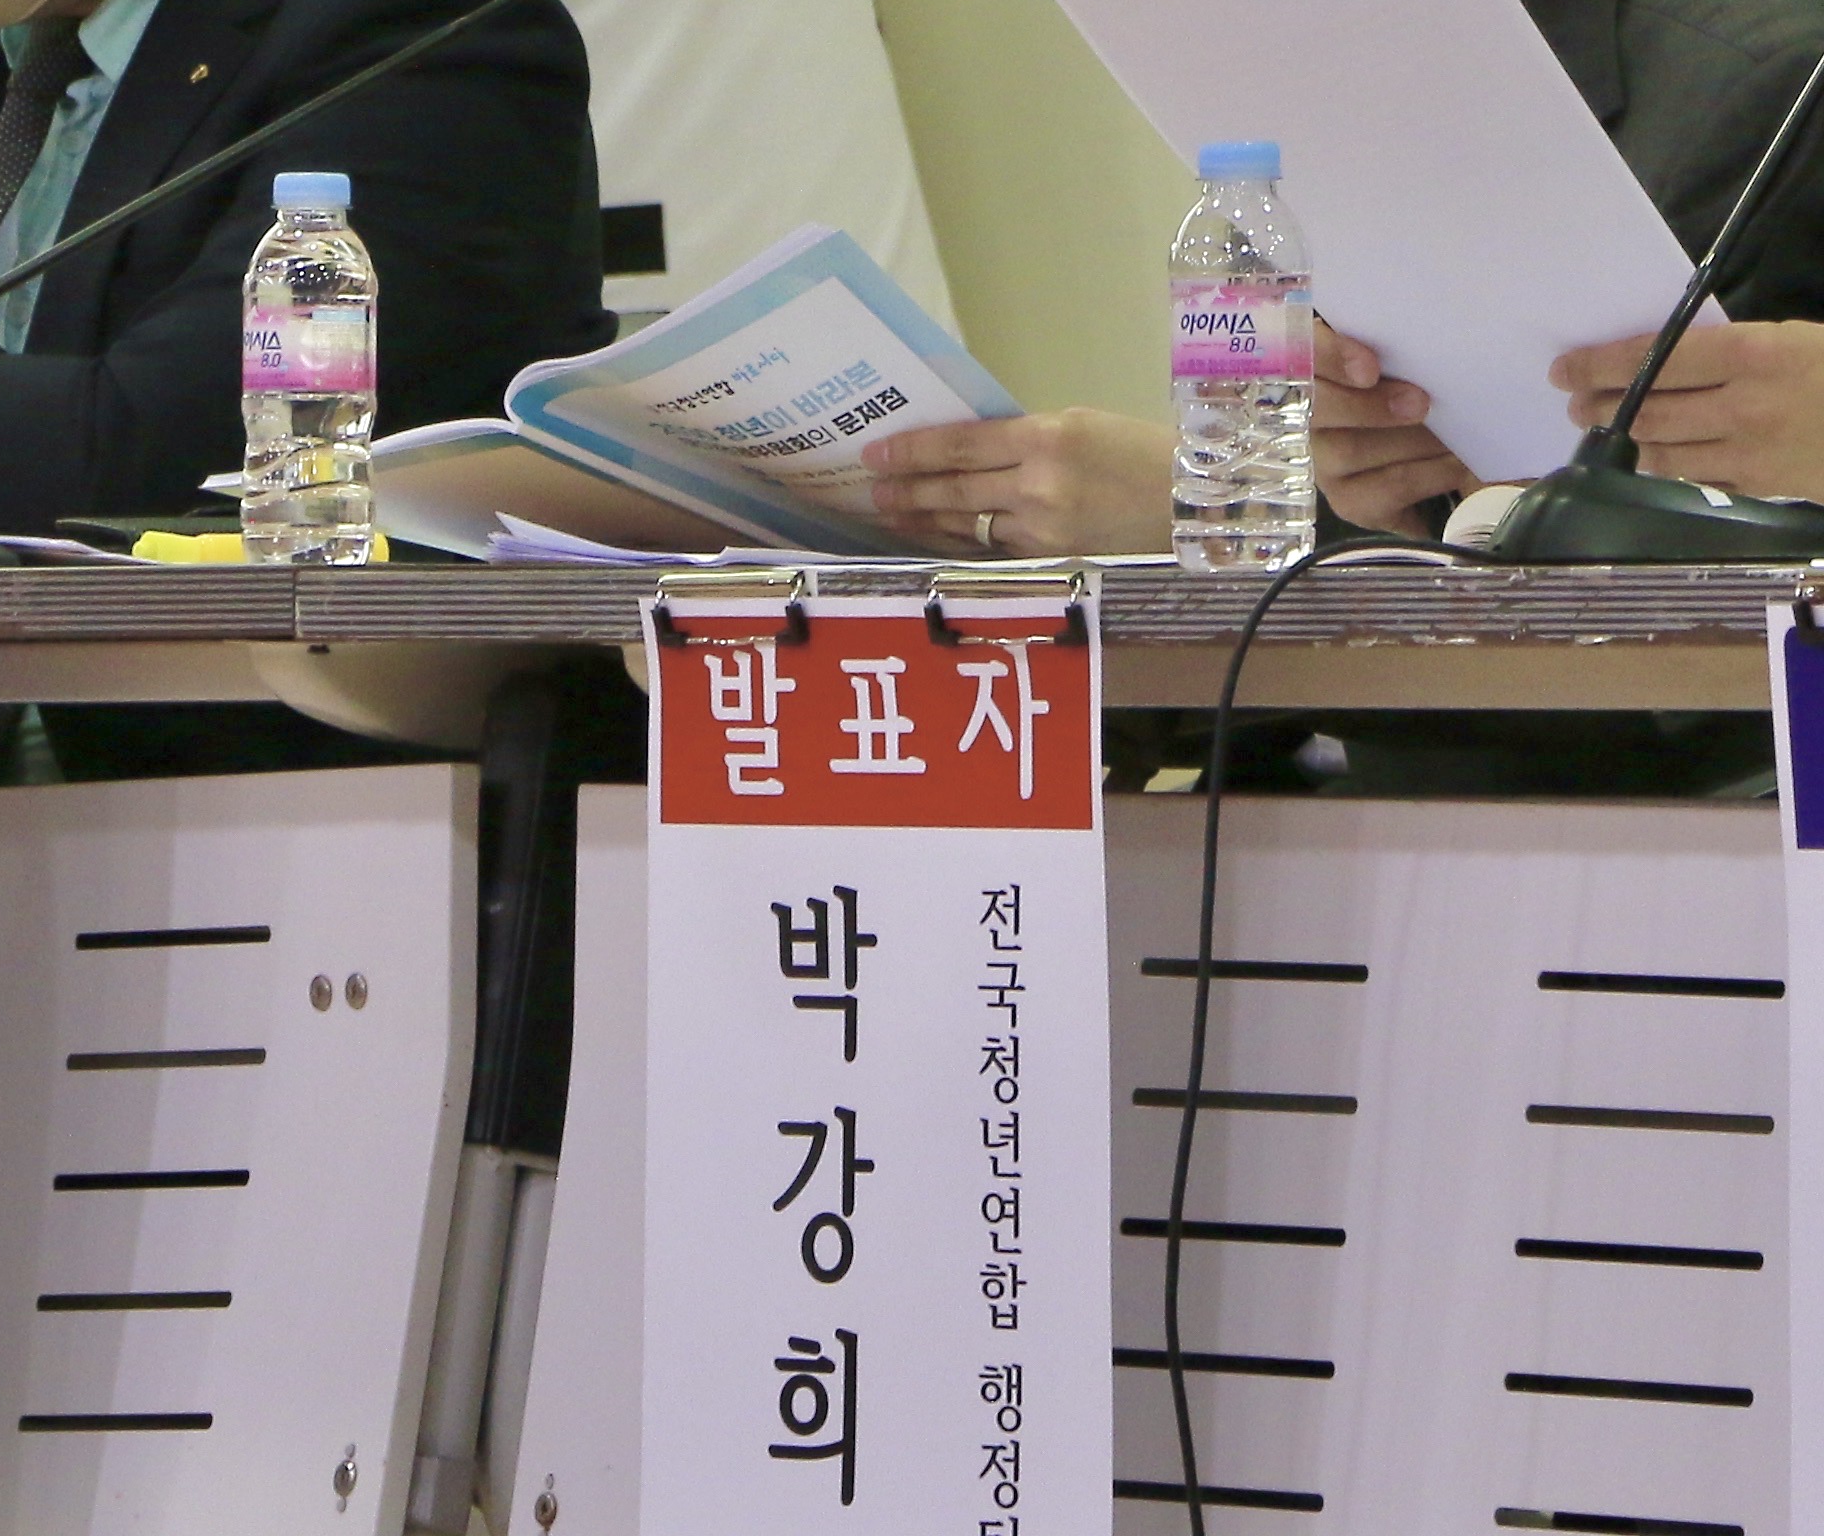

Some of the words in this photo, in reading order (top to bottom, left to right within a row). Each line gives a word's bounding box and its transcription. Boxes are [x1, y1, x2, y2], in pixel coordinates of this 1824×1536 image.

[1180, 312, 1256, 335] 아이시스
[1229, 336, 1256, 353] 8.0
[790, 359, 881, 418] 바라본
[831, 385, 910, 436] 문제점
[702, 642, 1051, 801] 발표자
[976, 883, 1028, 1331] 전국청년연합
[766, 884, 879, 1508] 박강희
